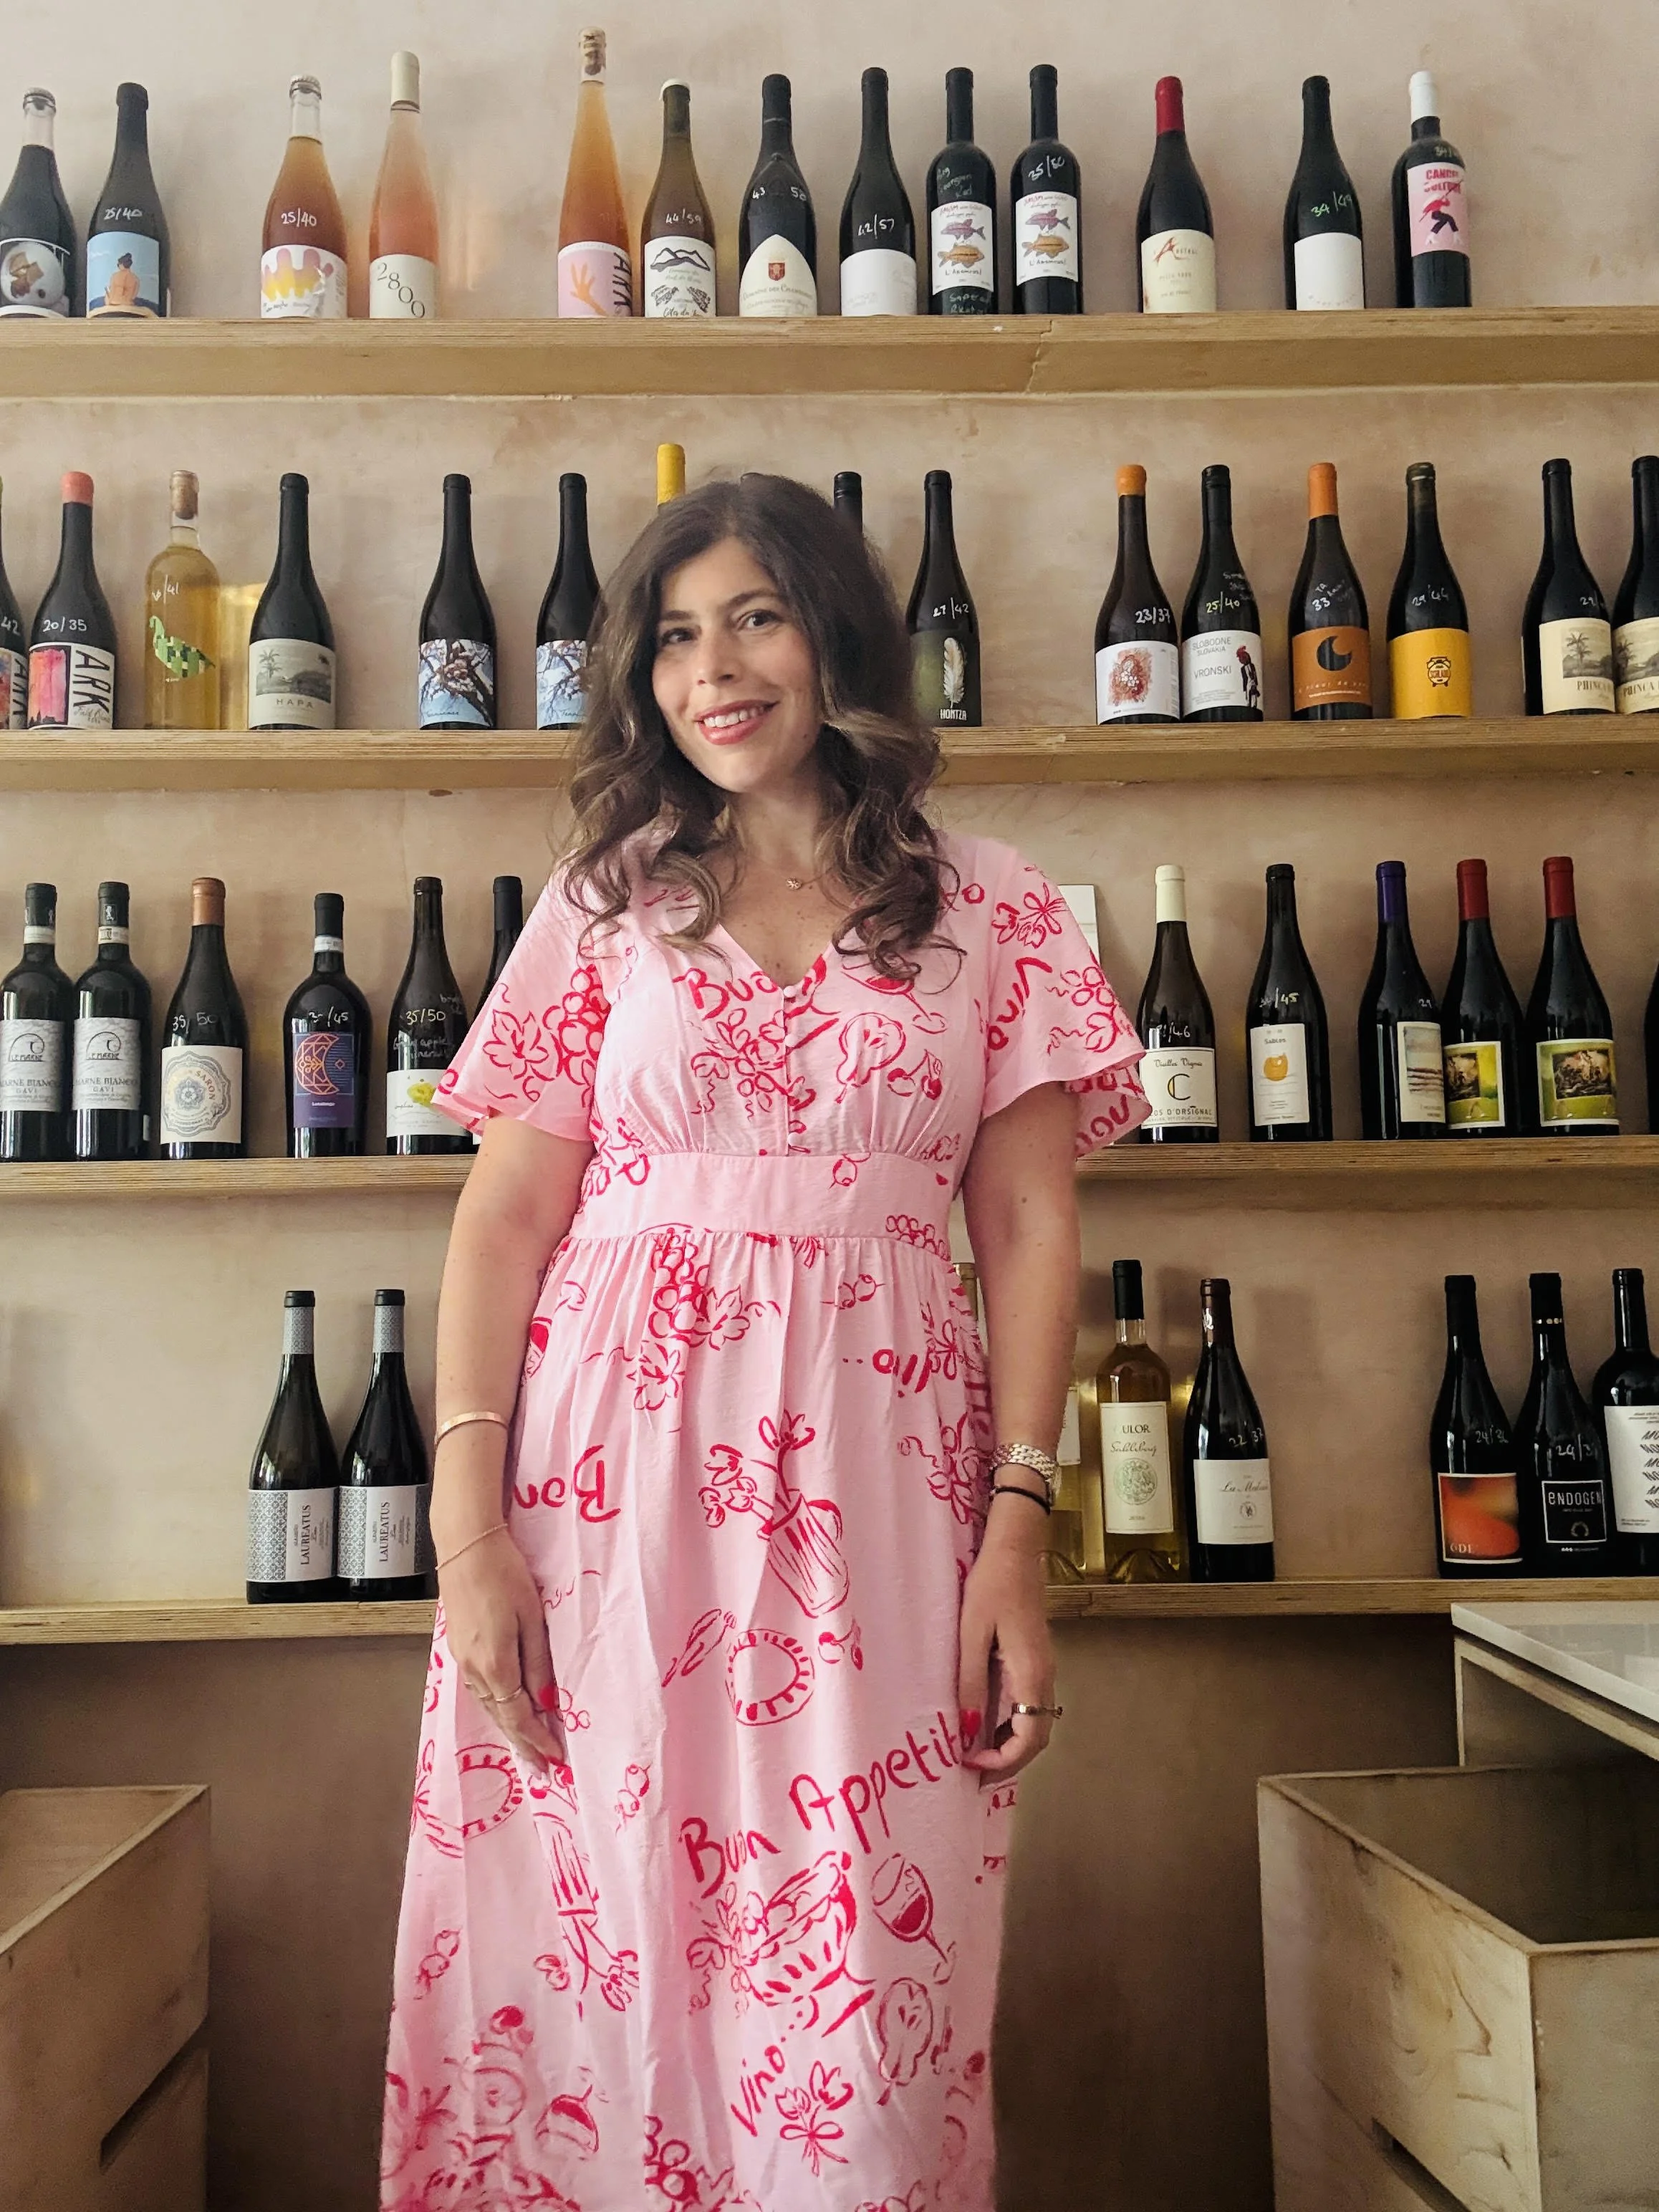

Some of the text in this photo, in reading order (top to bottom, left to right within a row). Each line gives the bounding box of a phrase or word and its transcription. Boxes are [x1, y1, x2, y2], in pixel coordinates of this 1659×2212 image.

[281, 207, 317, 228] 25/40
[857, 213, 895, 239] 42/57
[376, 261, 425, 318] 2800
[1206, 591, 1240, 614] 25/40
[42, 616, 87, 633] 20/35
[70, 649, 112, 714] ARK
[1193, 665, 1232, 680] VRONSKI
[940, 708, 967, 721] HONTZA
[405, 1008, 446, 1026] 35/50
[1122, 1424, 1151, 1434] ULOR
[300, 1504, 312, 1565] LAUREATUS
[379, 1501, 391, 1562] LAUREATUS
[731, 2044, 786, 2137] Vino
